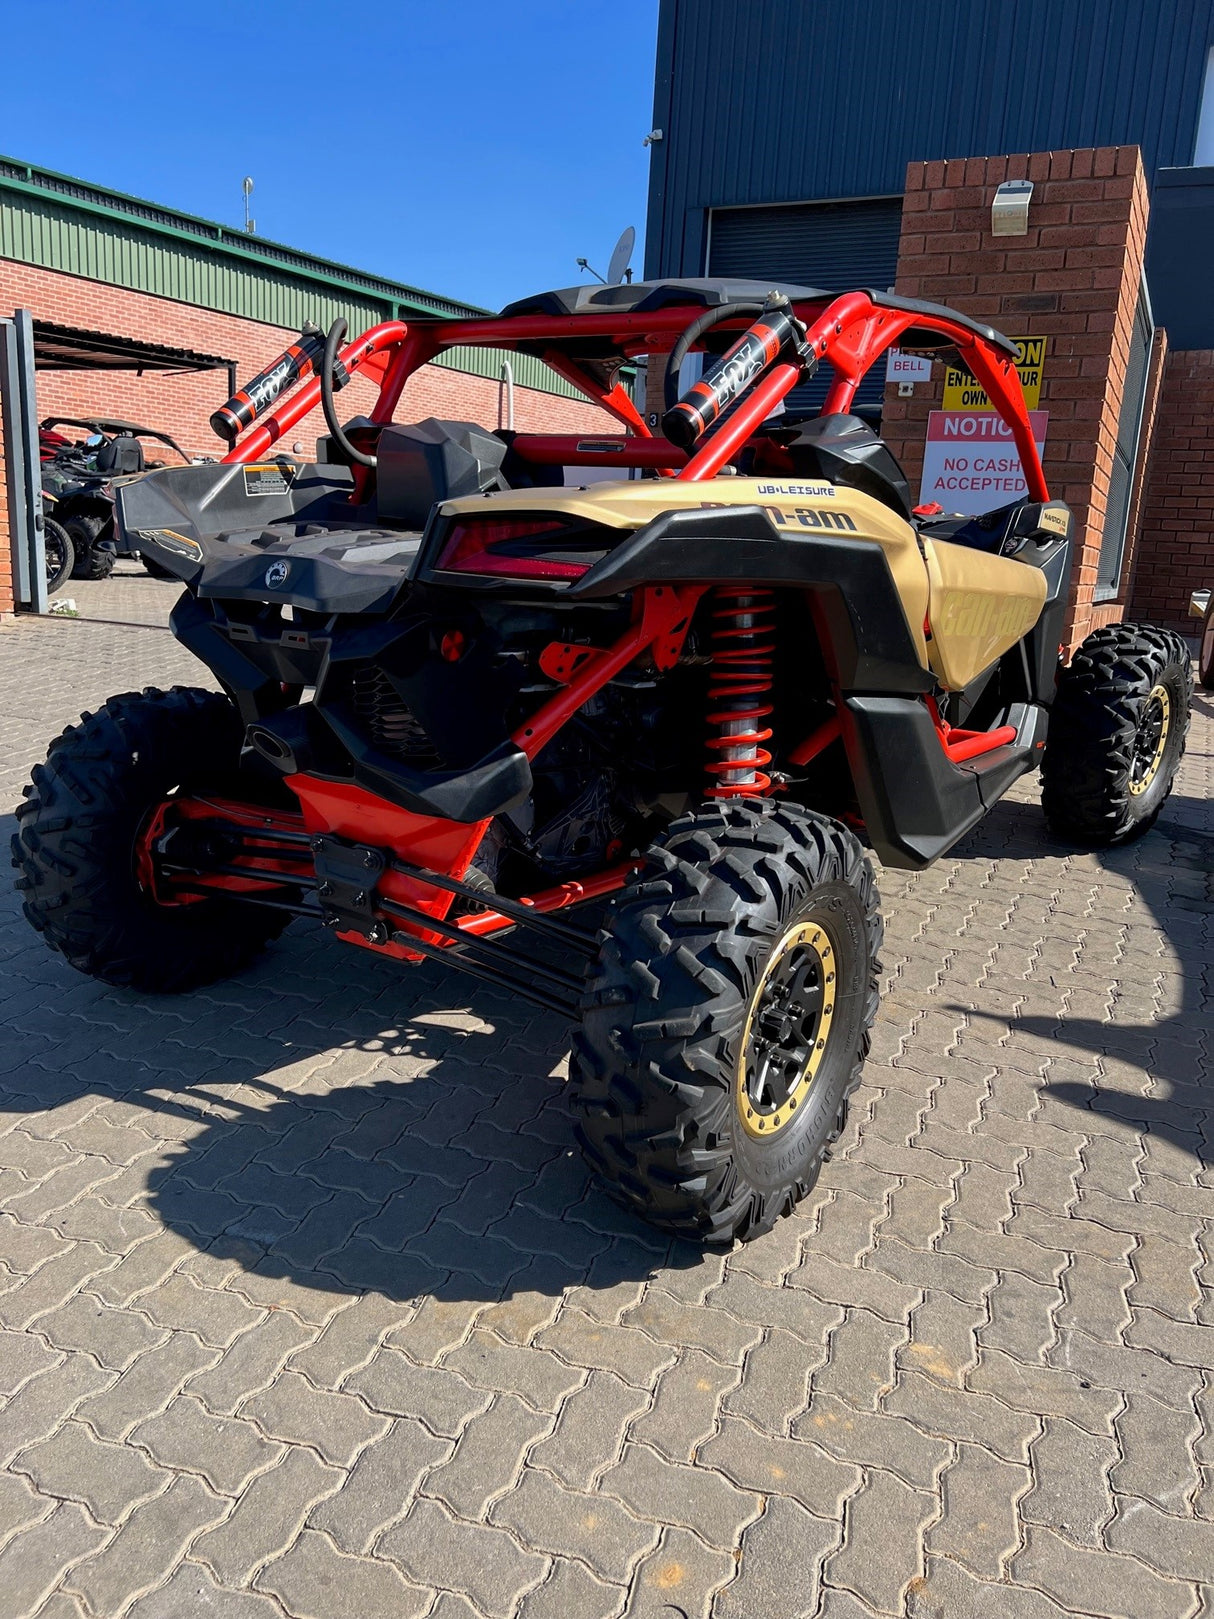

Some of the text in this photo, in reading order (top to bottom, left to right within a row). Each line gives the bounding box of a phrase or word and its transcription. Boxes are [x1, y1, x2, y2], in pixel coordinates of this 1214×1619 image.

[893, 360, 925, 371] BELL
[708, 343, 763, 407] FOX
[947, 371, 981, 387] ENTE
[962, 390, 988, 405] OWN
[649, 414, 657, 427] 3
[943, 417, 1013, 436] NOTIC
[944, 458, 1021, 472] NO CASH
[934, 476, 1026, 492] ACCEPTED
